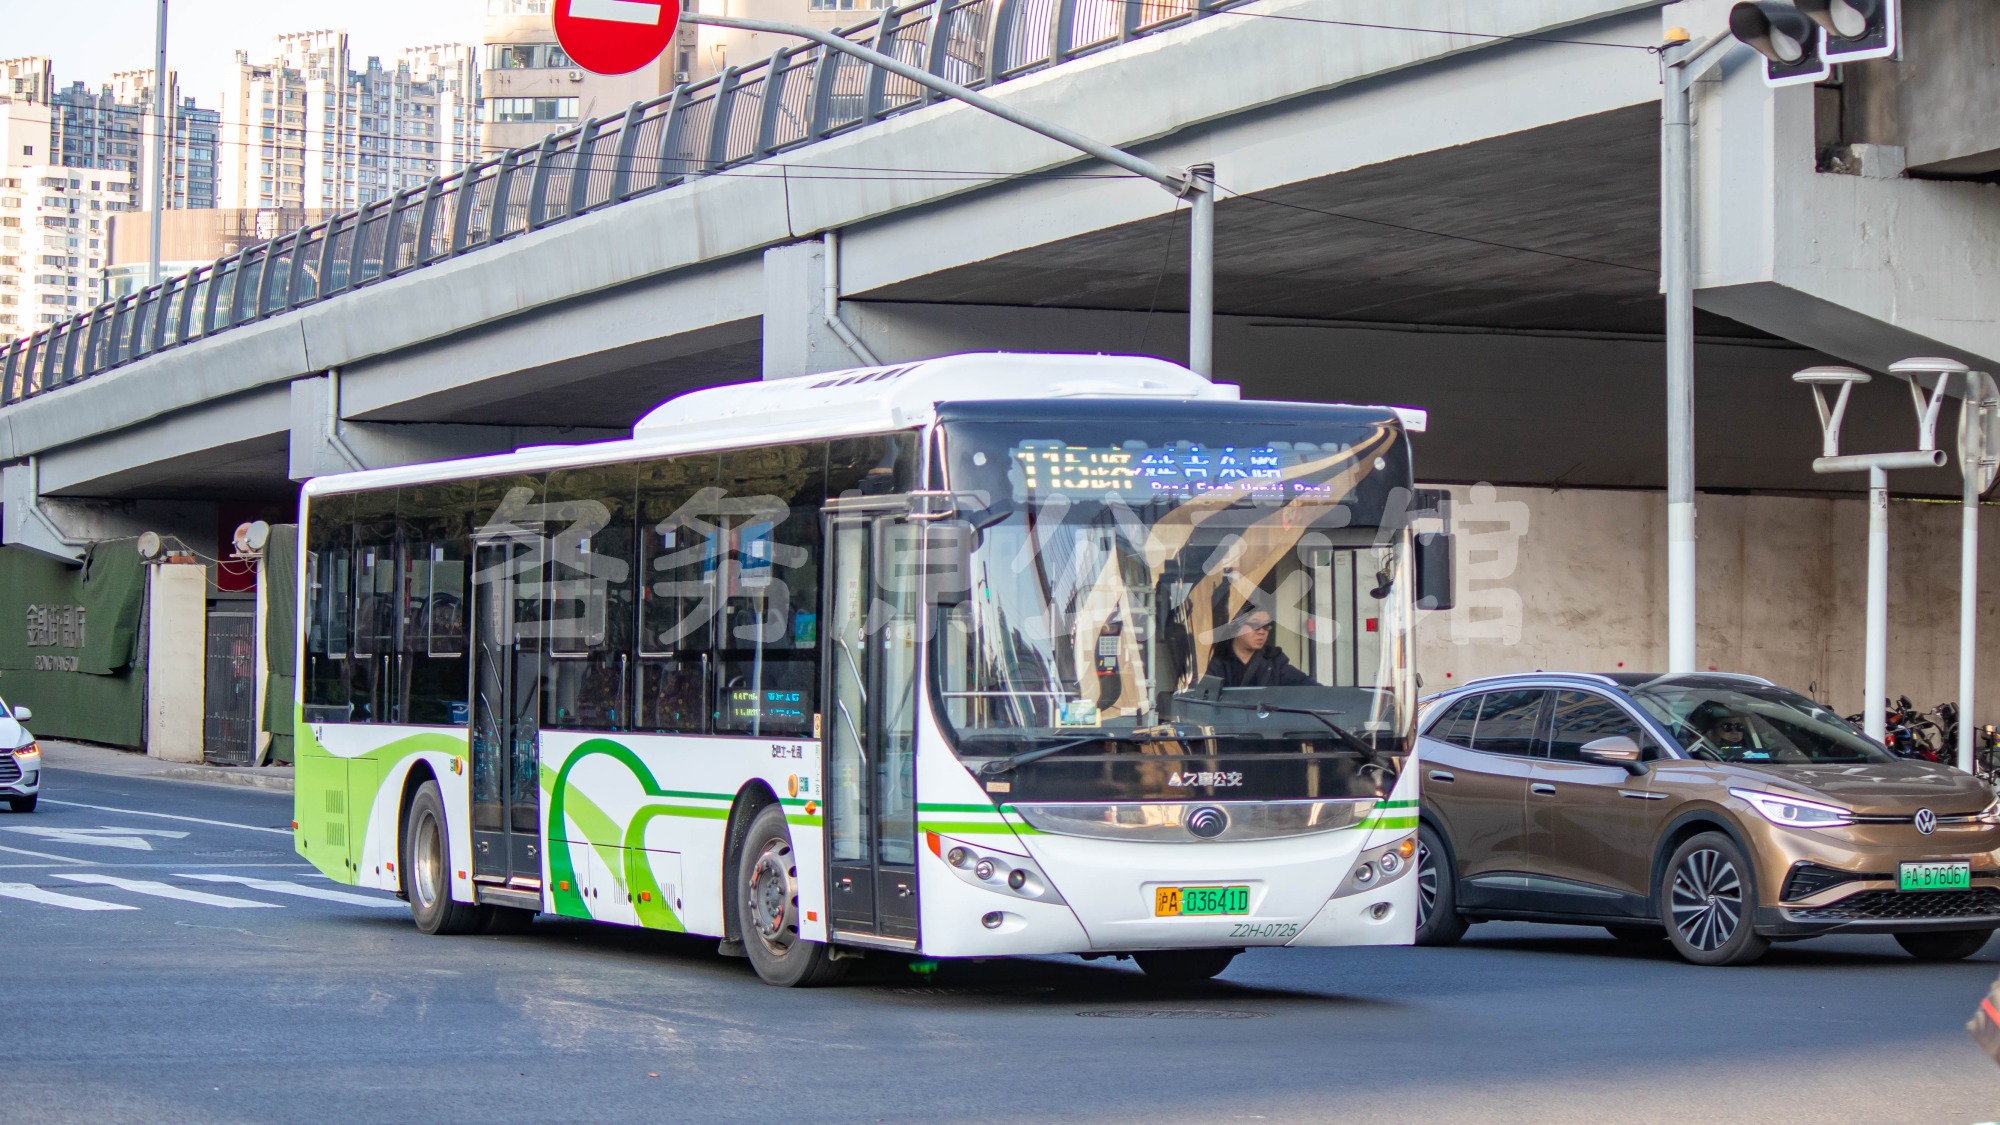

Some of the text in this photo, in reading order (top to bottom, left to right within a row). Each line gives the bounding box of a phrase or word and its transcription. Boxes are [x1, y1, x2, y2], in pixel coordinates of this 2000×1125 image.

[1183, 771, 1243, 787] 久事公交
[1229, 923, 1298, 938] Z2H-0725
